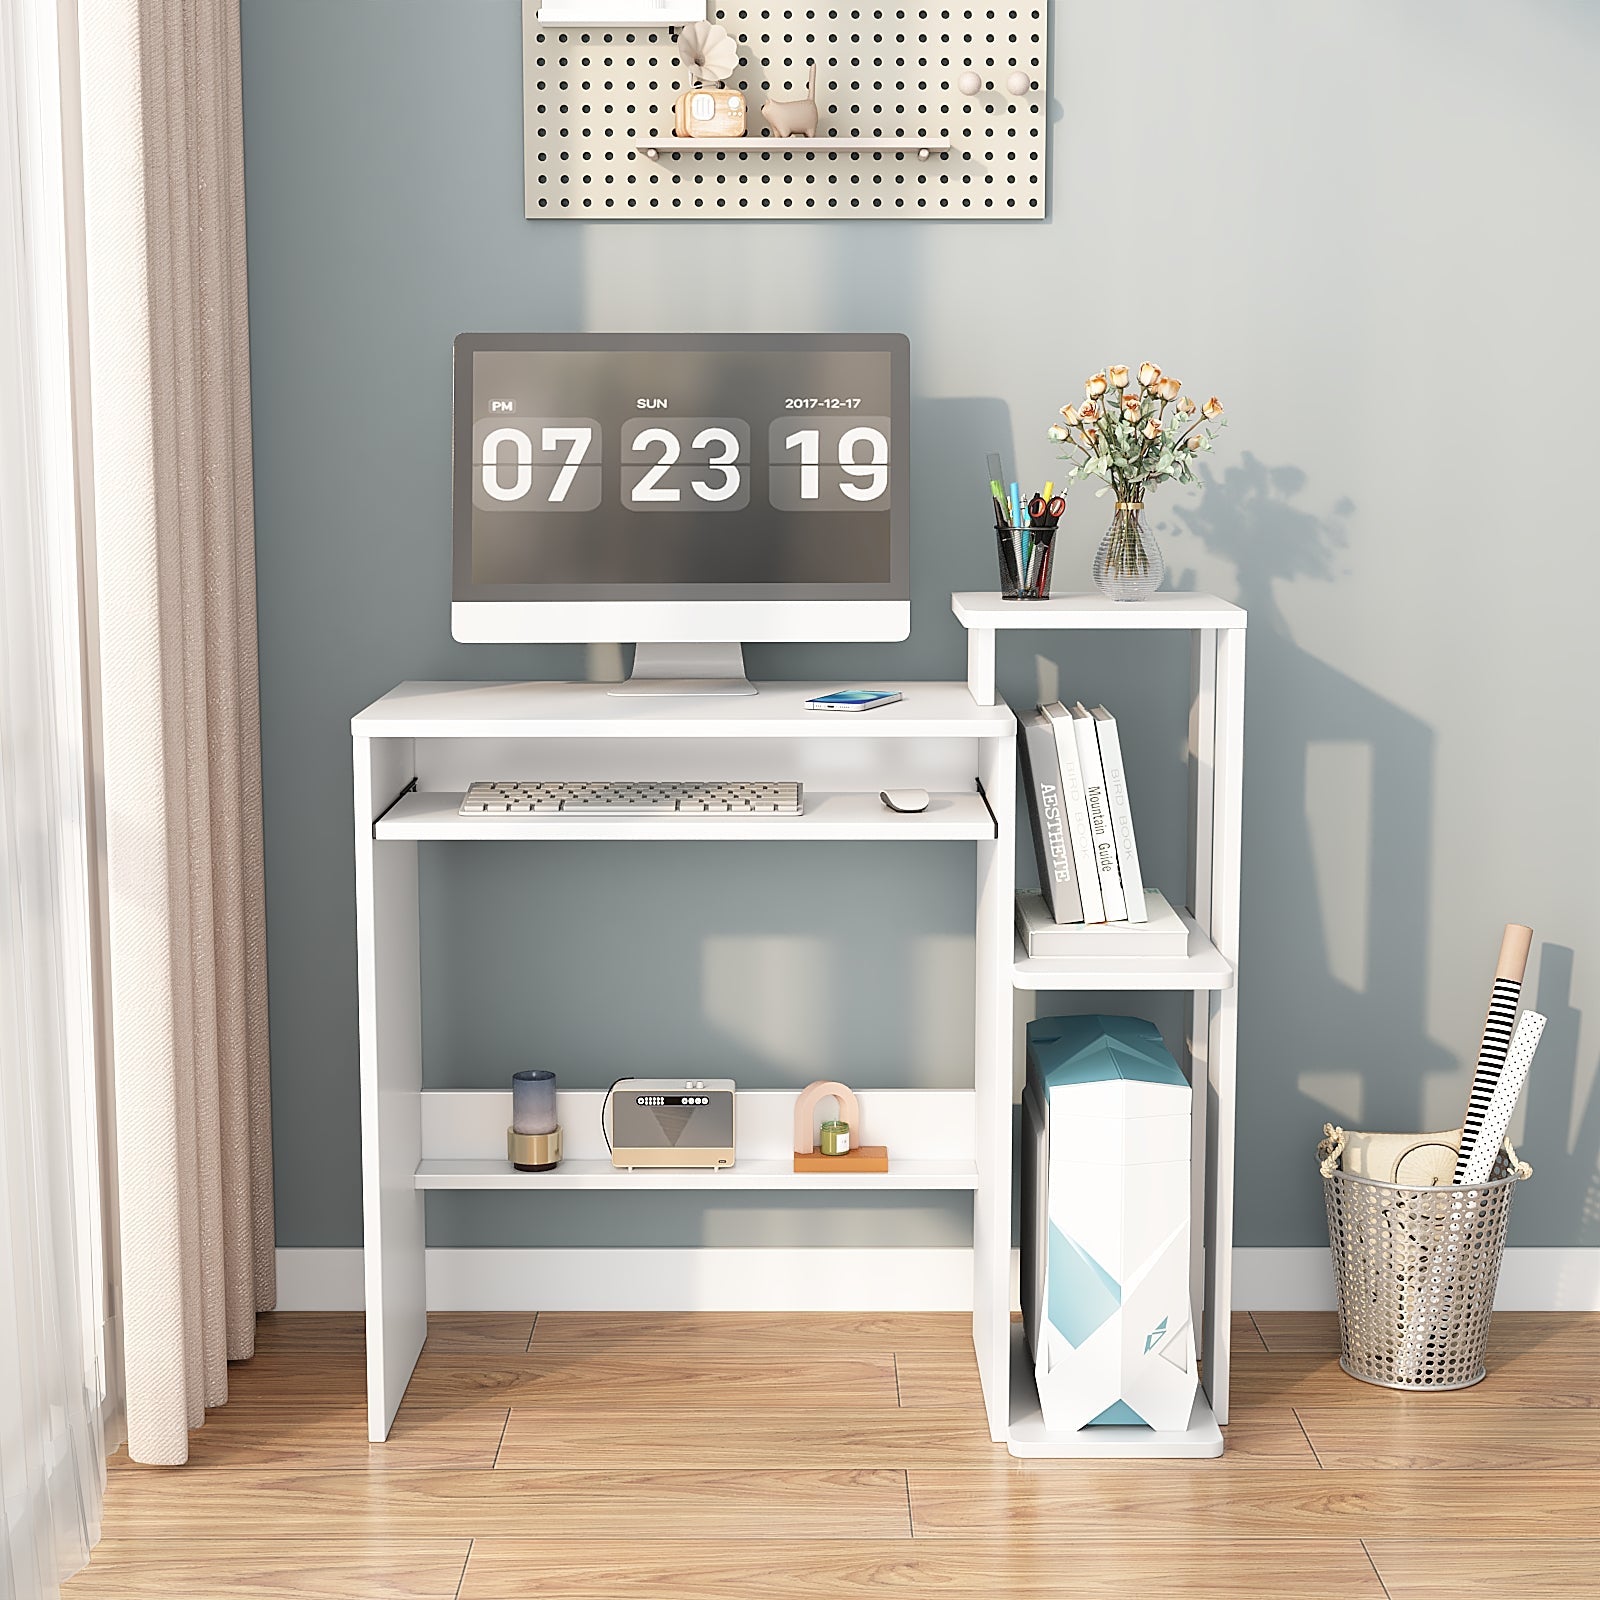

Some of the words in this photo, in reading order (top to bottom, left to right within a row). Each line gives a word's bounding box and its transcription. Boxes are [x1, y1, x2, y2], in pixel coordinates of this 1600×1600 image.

[491, 401, 513, 411] PM
[637, 398, 668, 409] SUN
[785, 398, 861, 409] 2017-12-17
[482, 428, 592, 501] 07
[631, 428, 740, 501] 23
[785, 427, 888, 501] 19
[1041, 783, 1070, 883] AESTHETE
[1064, 761, 1079, 801] BIRD
[1075, 812, 1090, 860] BOOK
[1088, 785, 1106, 835] Mountain
[1098, 843, 1113, 872] Guide
[1110, 769, 1124, 806] BIRD
[1119, 816, 1134, 862] BOOK
